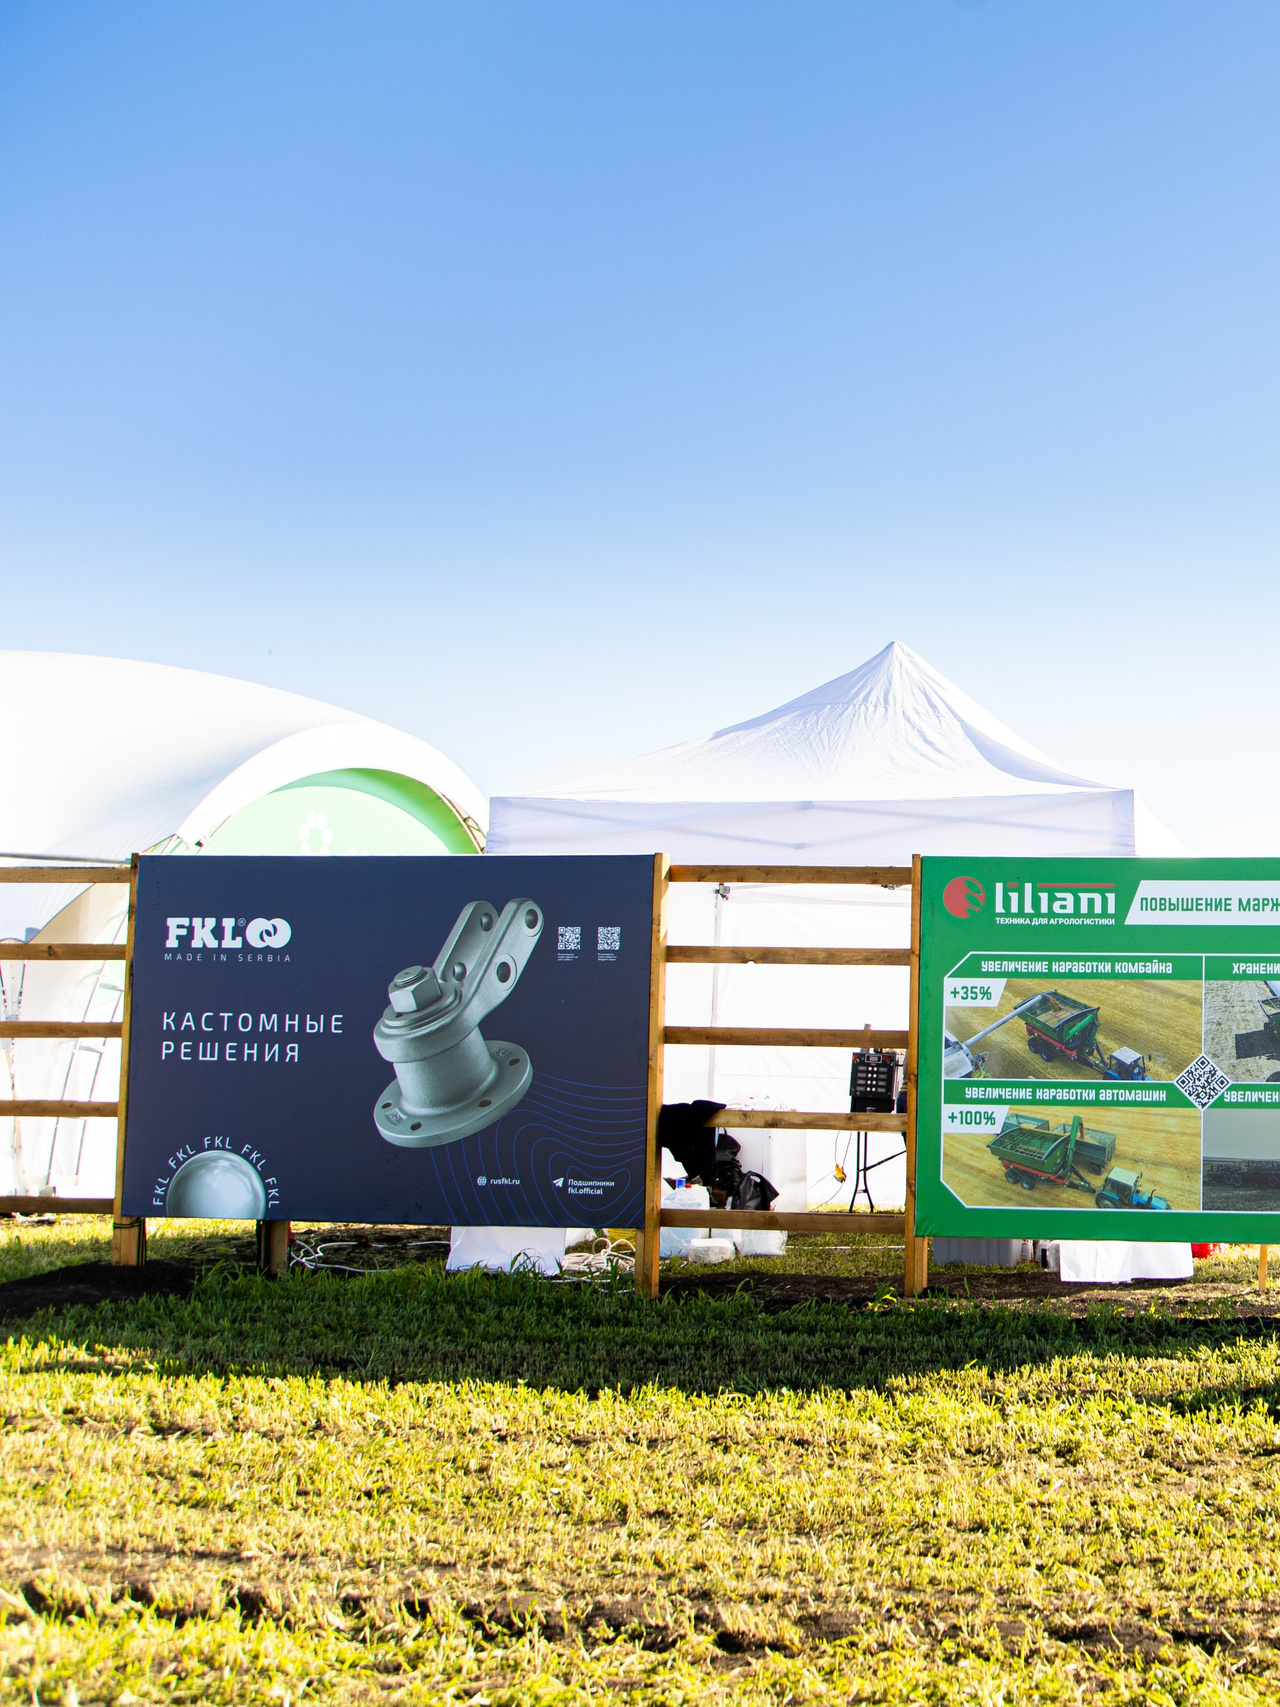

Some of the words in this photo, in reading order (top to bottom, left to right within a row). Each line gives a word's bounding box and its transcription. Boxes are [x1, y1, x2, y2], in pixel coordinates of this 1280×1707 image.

[995, 882, 1115, 914] liliani
[1140, 897, 1232, 912] ПОВЫШЕНИЕ
[995, 917, 1031, 925] ТЕХНИКА
[1031, 917, 1048, 925] ДЛЯ
[165, 917, 243, 948] FKL
[164, 953, 202, 961] MADE
[213, 953, 227, 961] IN
[238, 954, 291, 962] SERBIA
[981, 960, 1049, 972] УВЕЛИЧЕНИЕ
[950, 986, 992, 1000] +35%
[162, 1011, 343, 1034] КАСТОМНЫЕ
[161, 1041, 299, 1063] РЕШЕНИЯ
[965, 1087, 1033, 1100] УВЕЛИЧЕНИЕ
[948, 1111, 996, 1126] +100%
[204, 1136, 232, 1149] FKL
[168, 1144, 196, 1169] FKL
[241, 1144, 266, 1171] FKL
[568, 1179, 615, 1187] Подшипники
[152, 1177, 170, 1205] FKL
[265, 1177, 280, 1208] FKL
